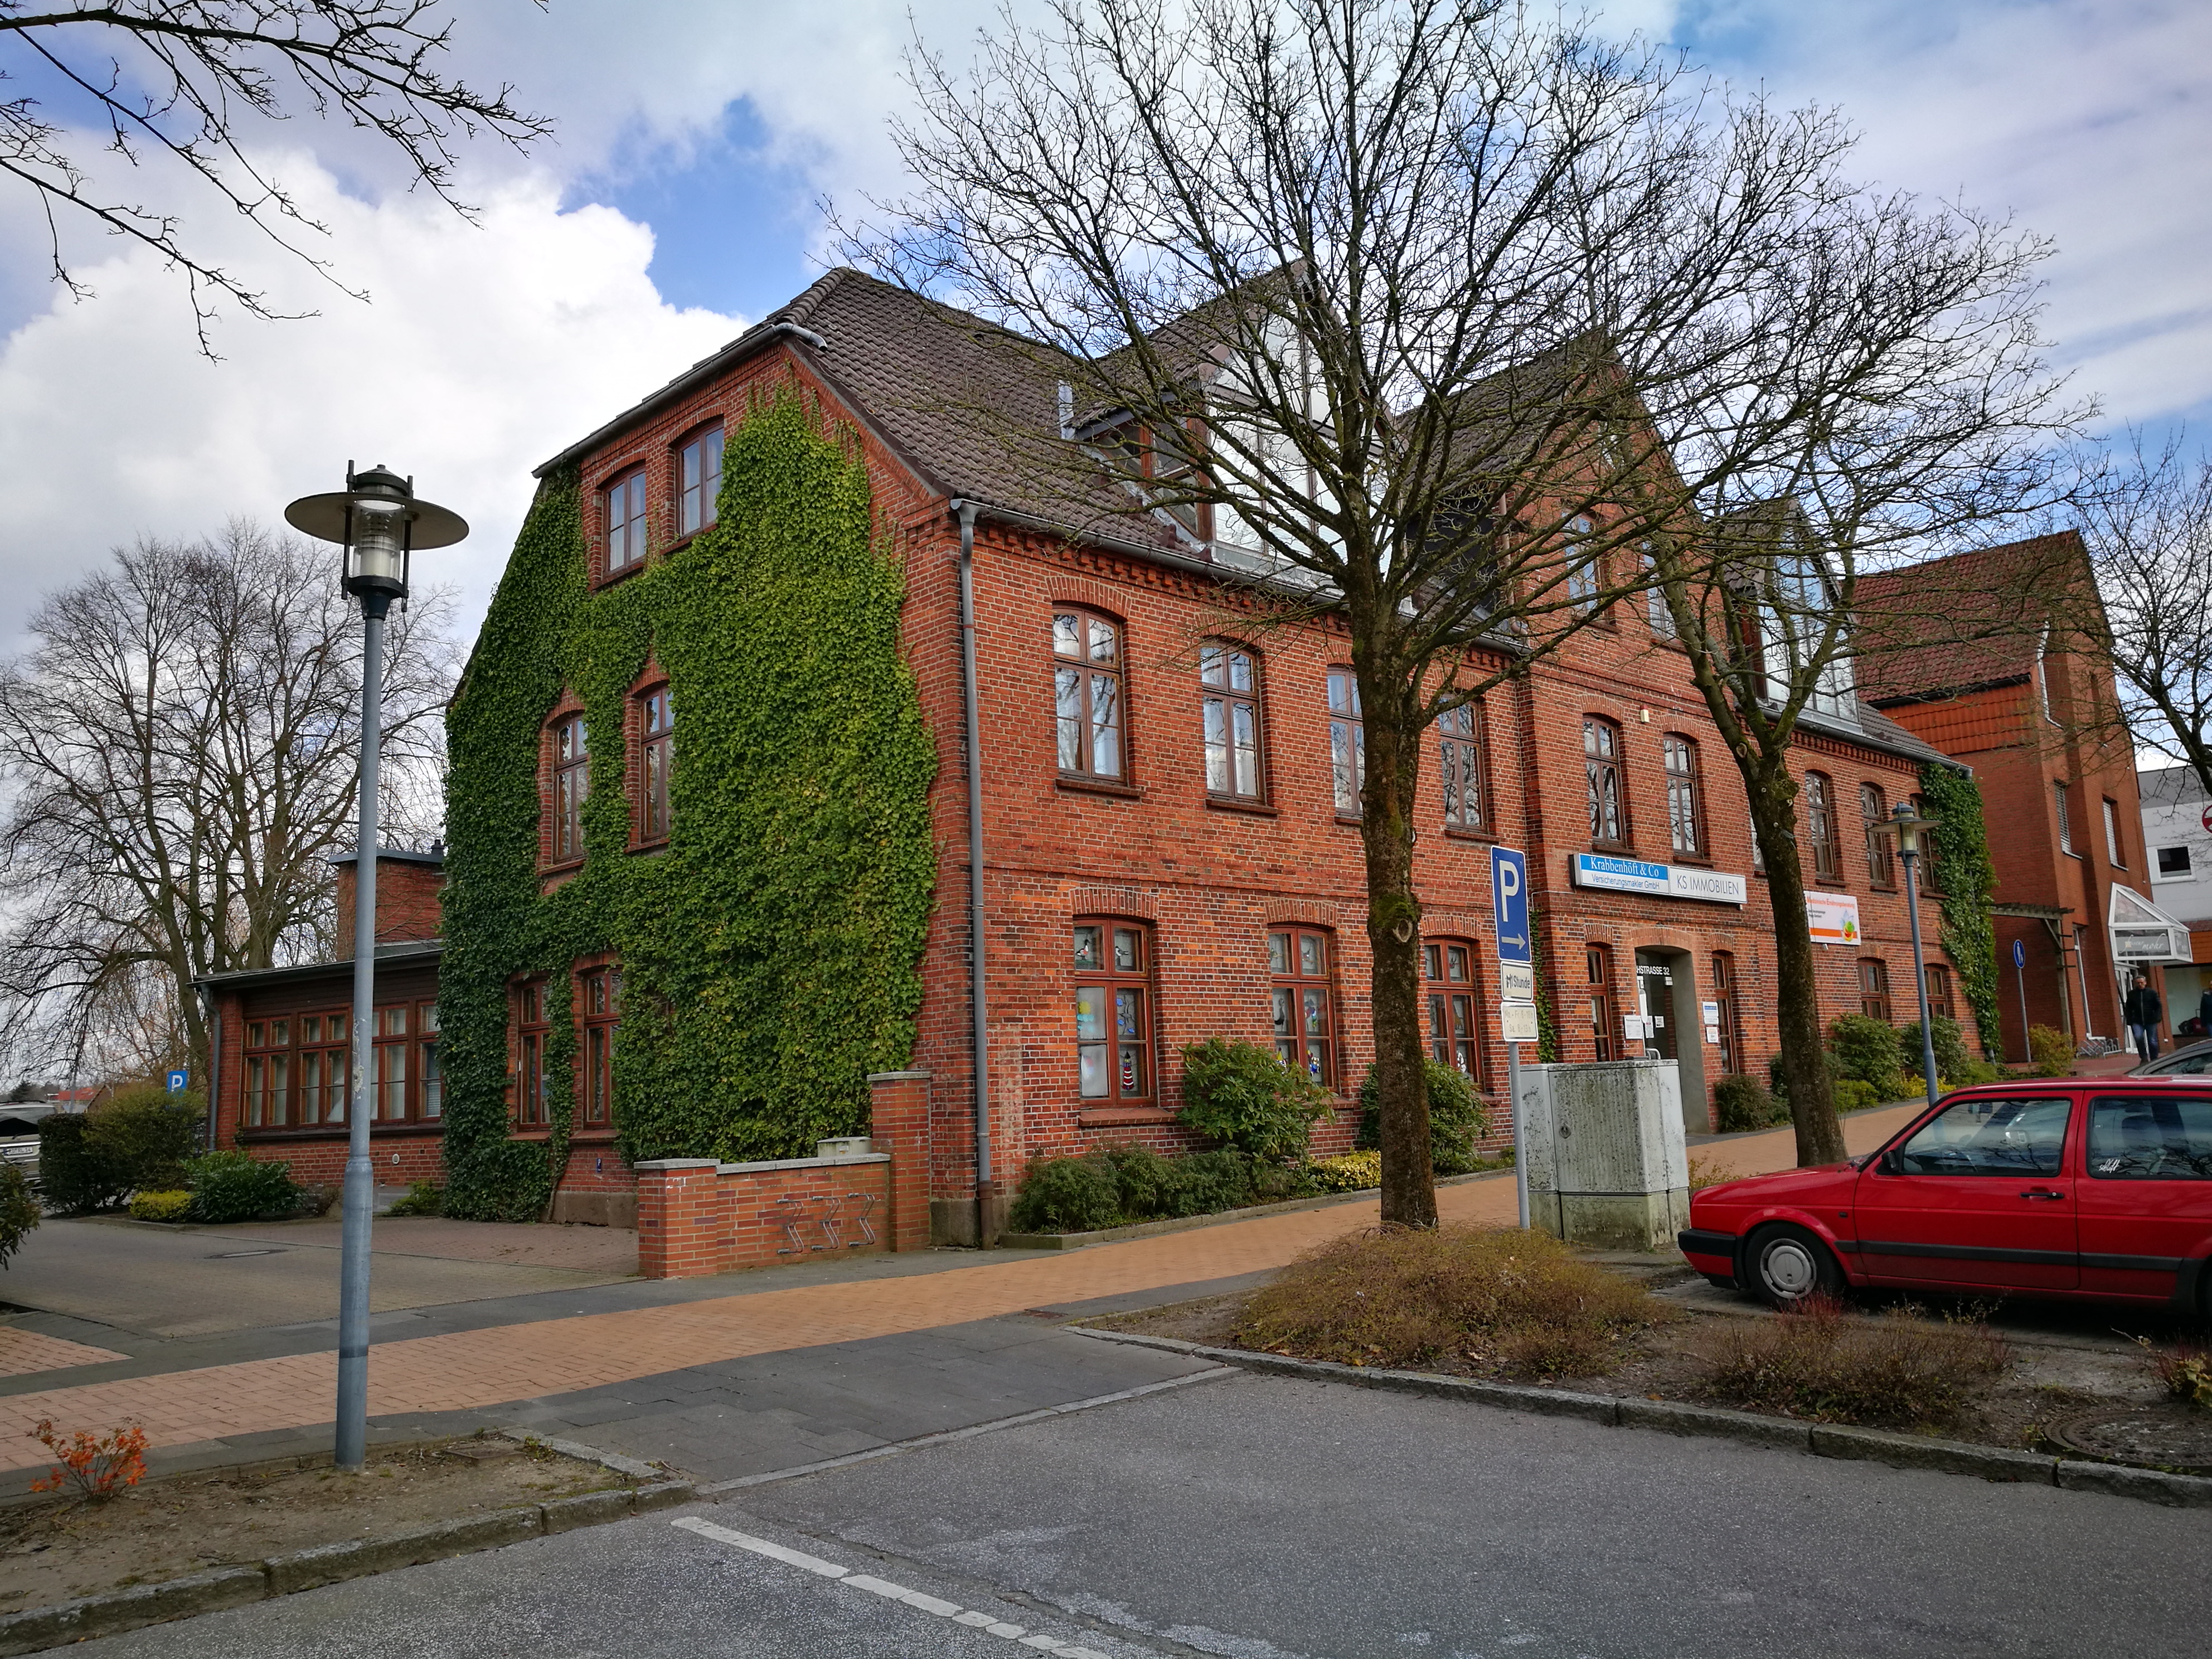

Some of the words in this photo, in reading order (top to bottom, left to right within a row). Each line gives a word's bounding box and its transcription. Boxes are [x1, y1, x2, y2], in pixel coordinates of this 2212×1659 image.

[1590, 857, 1638, 875] Krabbenhöft
[1640, 864, 1647, 876] &
[1648, 865, 1659, 877] Co
[1499, 860, 1520, 922] P
[1592, 874, 1643, 888] Versicherungsmakler
[1645, 880, 1660, 890] GmbH
[1677, 875, 1687, 890] KS
[1690, 876, 1739, 895] IMMOBILIEN
[1663, 967, 1670, 975] 32
[171, 1074, 183, 1092] P
